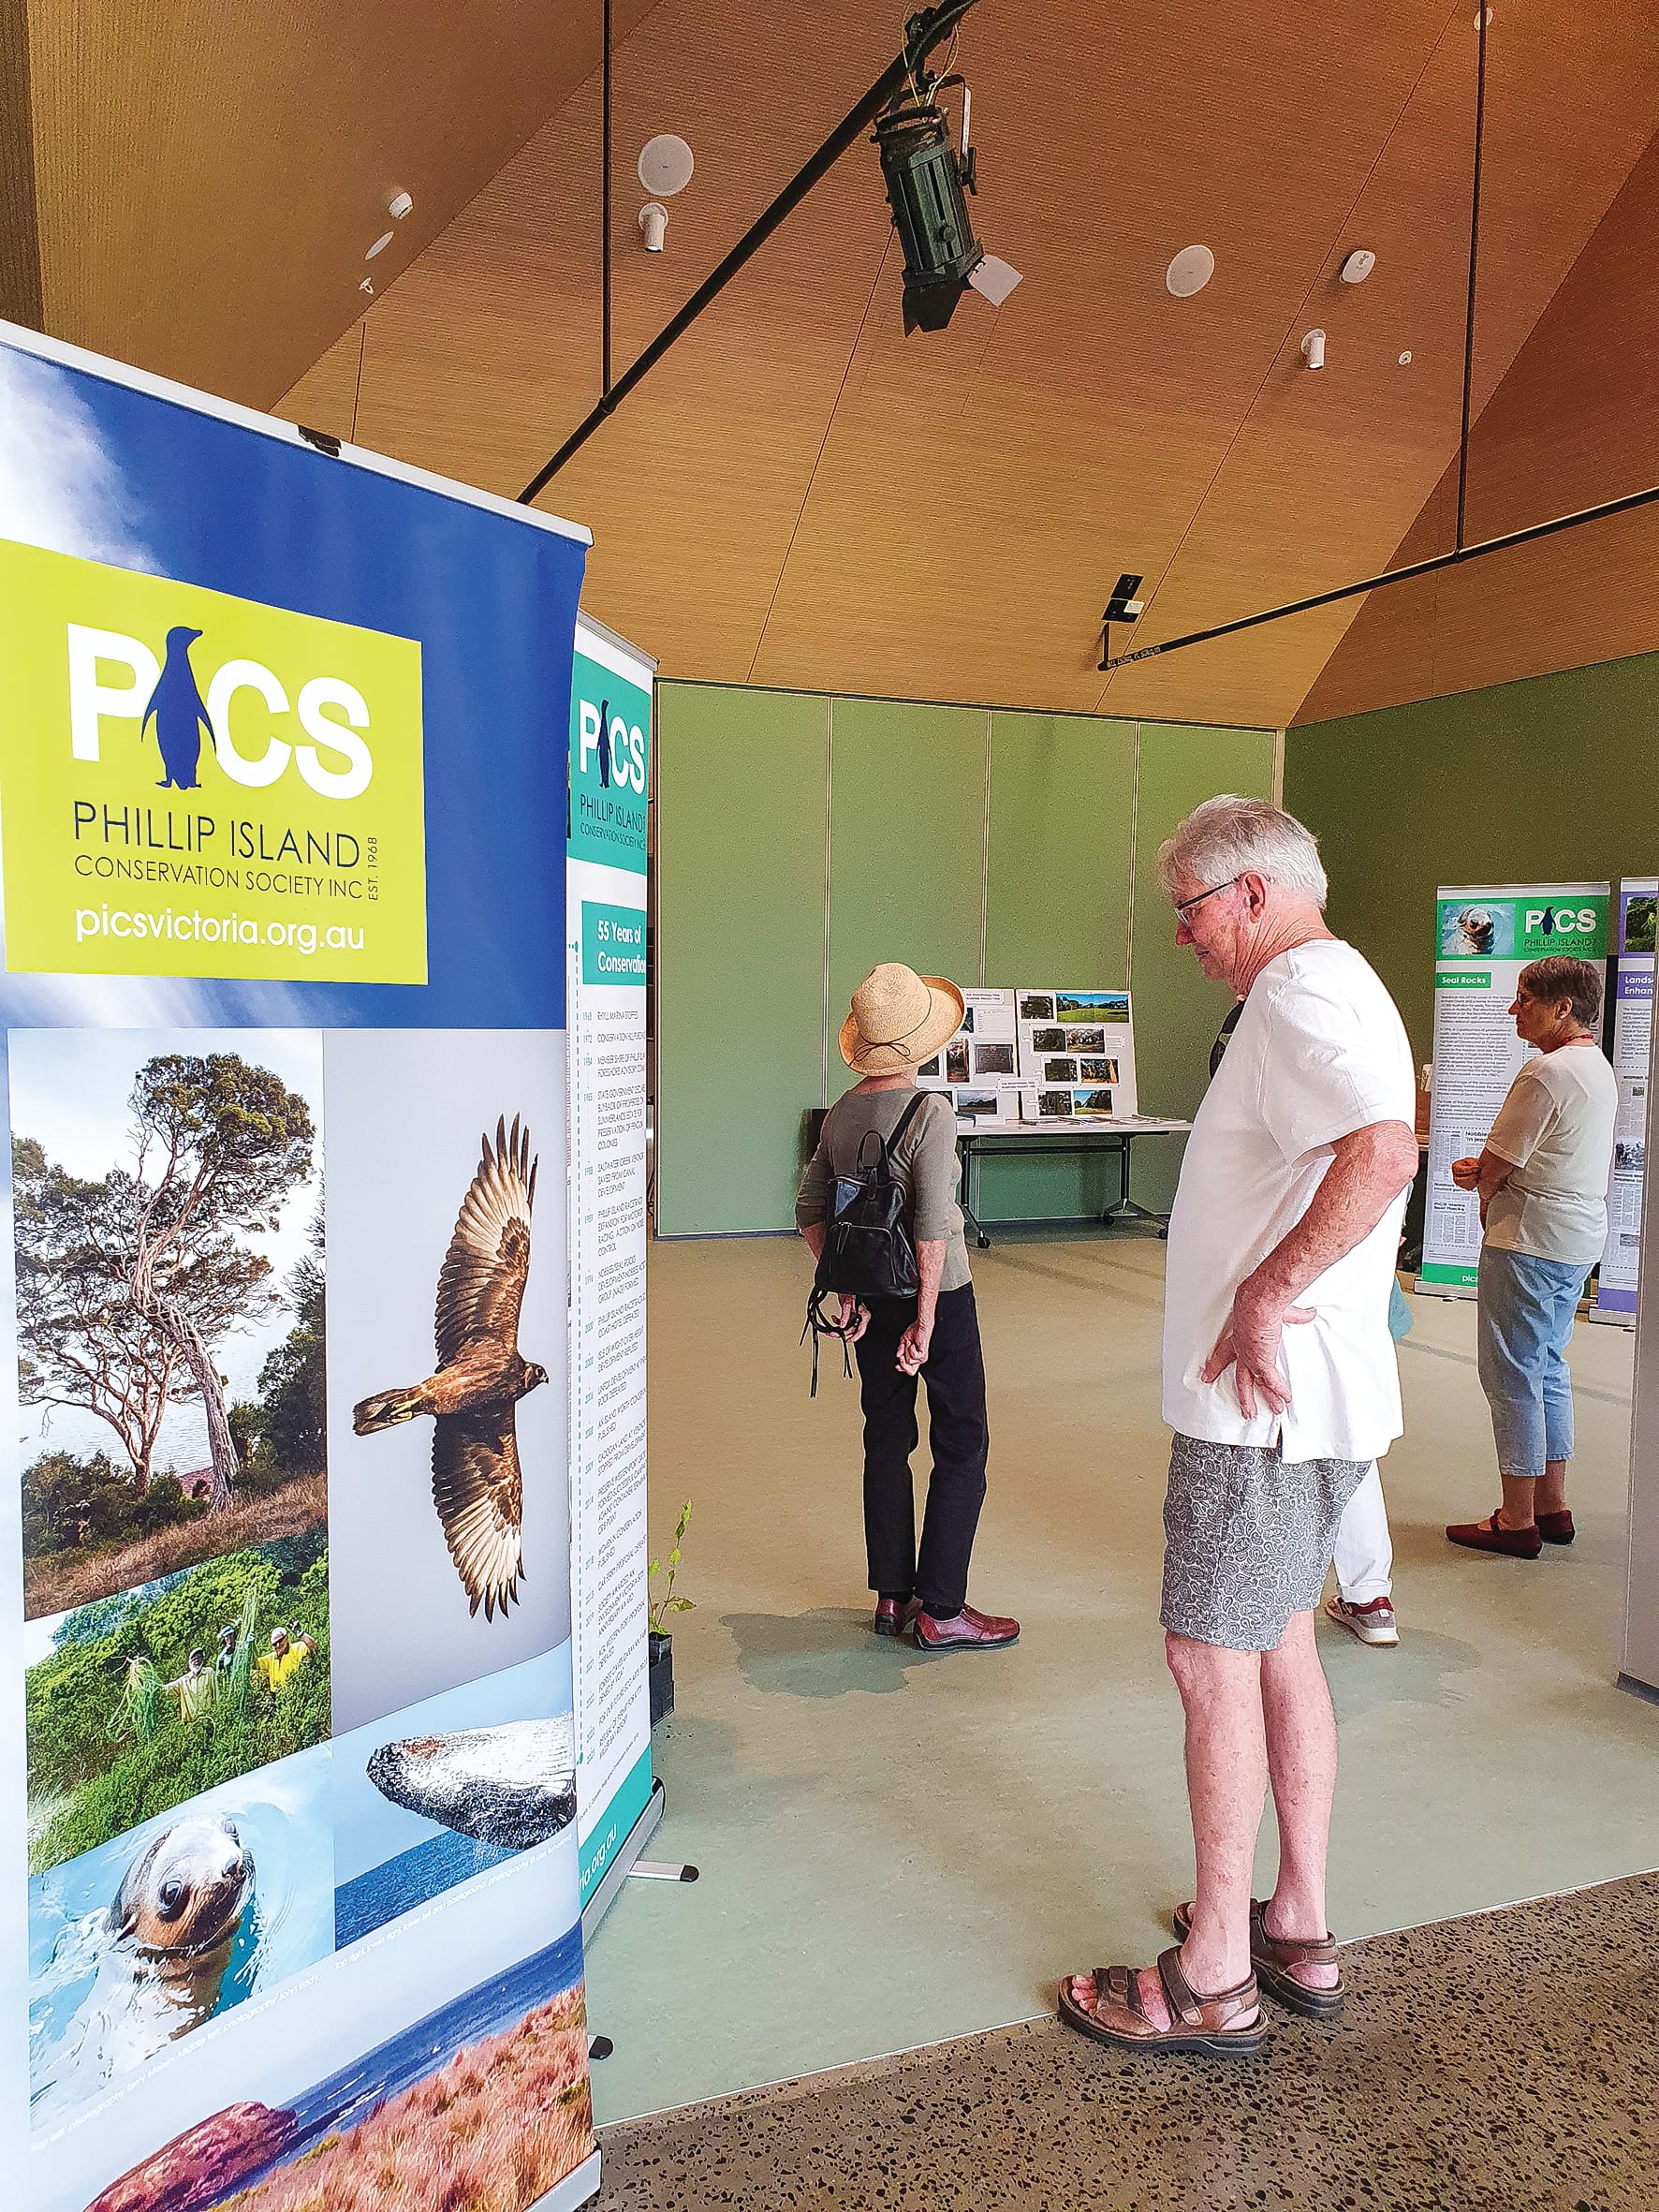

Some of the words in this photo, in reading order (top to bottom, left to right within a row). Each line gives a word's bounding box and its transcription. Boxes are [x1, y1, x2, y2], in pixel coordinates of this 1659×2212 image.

[580, 793, 613, 823] PHILLIP
[616, 805, 643, 833] ISLAND
[74, 801, 214, 852] PHILLIP
[230, 820, 360, 869] ISLAND
[367, 837, 378, 868] 1968
[75, 855, 239, 889] CONSERVATION
[245, 871, 323, 898] SOCIETY
[329, 878, 363, 900] INC
[367, 876, 378, 900] EST.
[76, 904, 365, 955] picsvictoria.org.au
[597, 920, 609, 941] 55
[610, 921, 634, 943] Years
[634, 924, 641, 944] of
[1524, 938, 1555, 947] PHILLIP
[1558, 938, 1592, 947] ISLAND
[1442, 976, 1459, 984] Seal
[1461, 976, 1486, 984] Rocks
[1625, 976, 1653, 984] Lands
